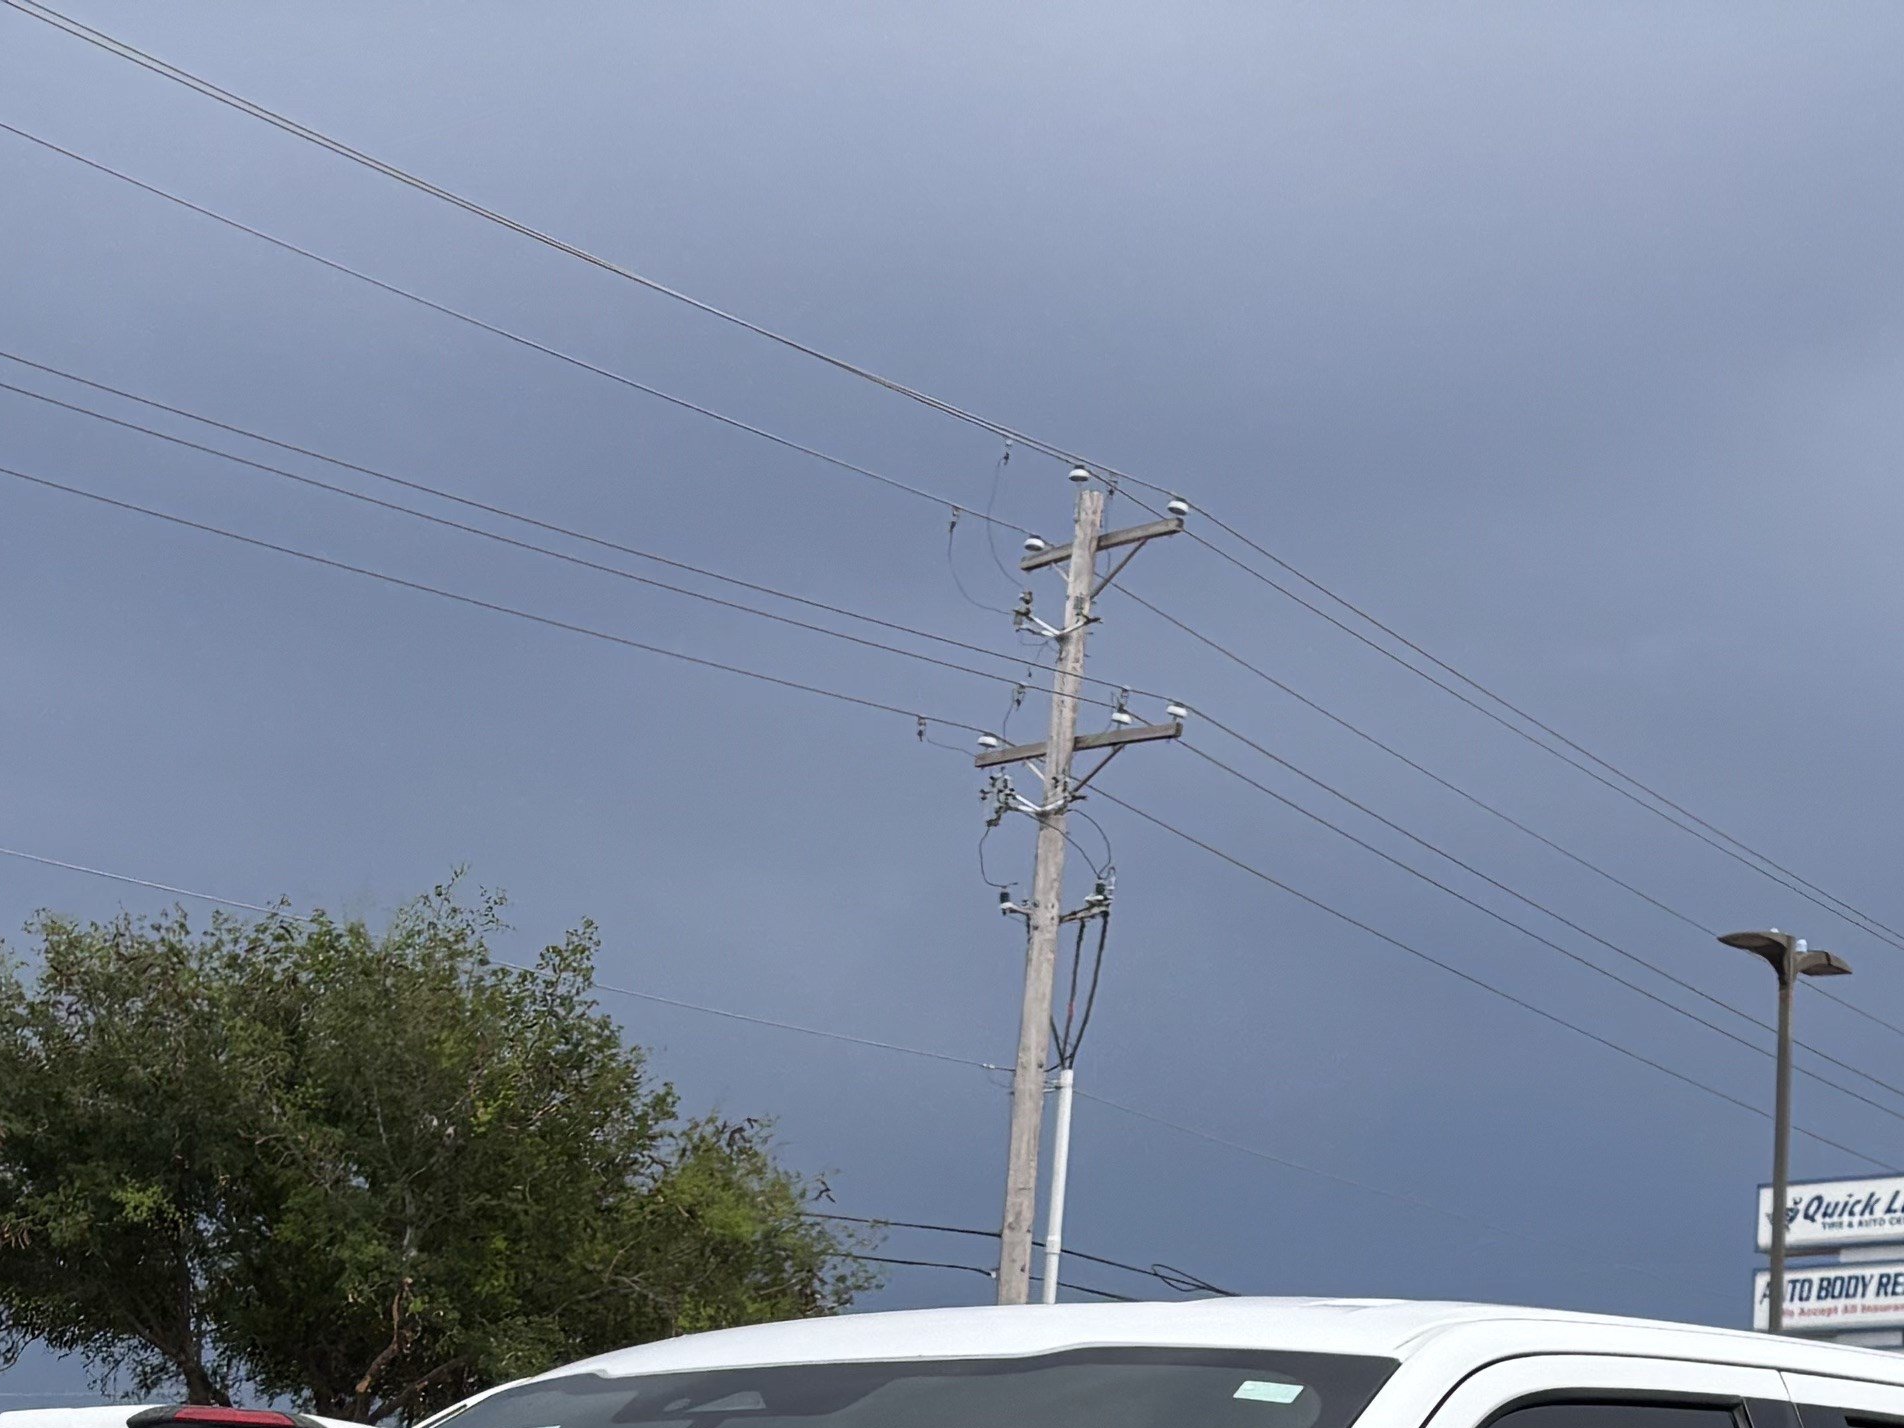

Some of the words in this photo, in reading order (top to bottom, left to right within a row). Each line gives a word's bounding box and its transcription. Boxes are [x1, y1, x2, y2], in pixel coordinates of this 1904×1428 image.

[1802, 1191, 1878, 1223] Quick
[1759, 1277, 1814, 1305] ATO
[1816, 1272, 1877, 1301] BODY
